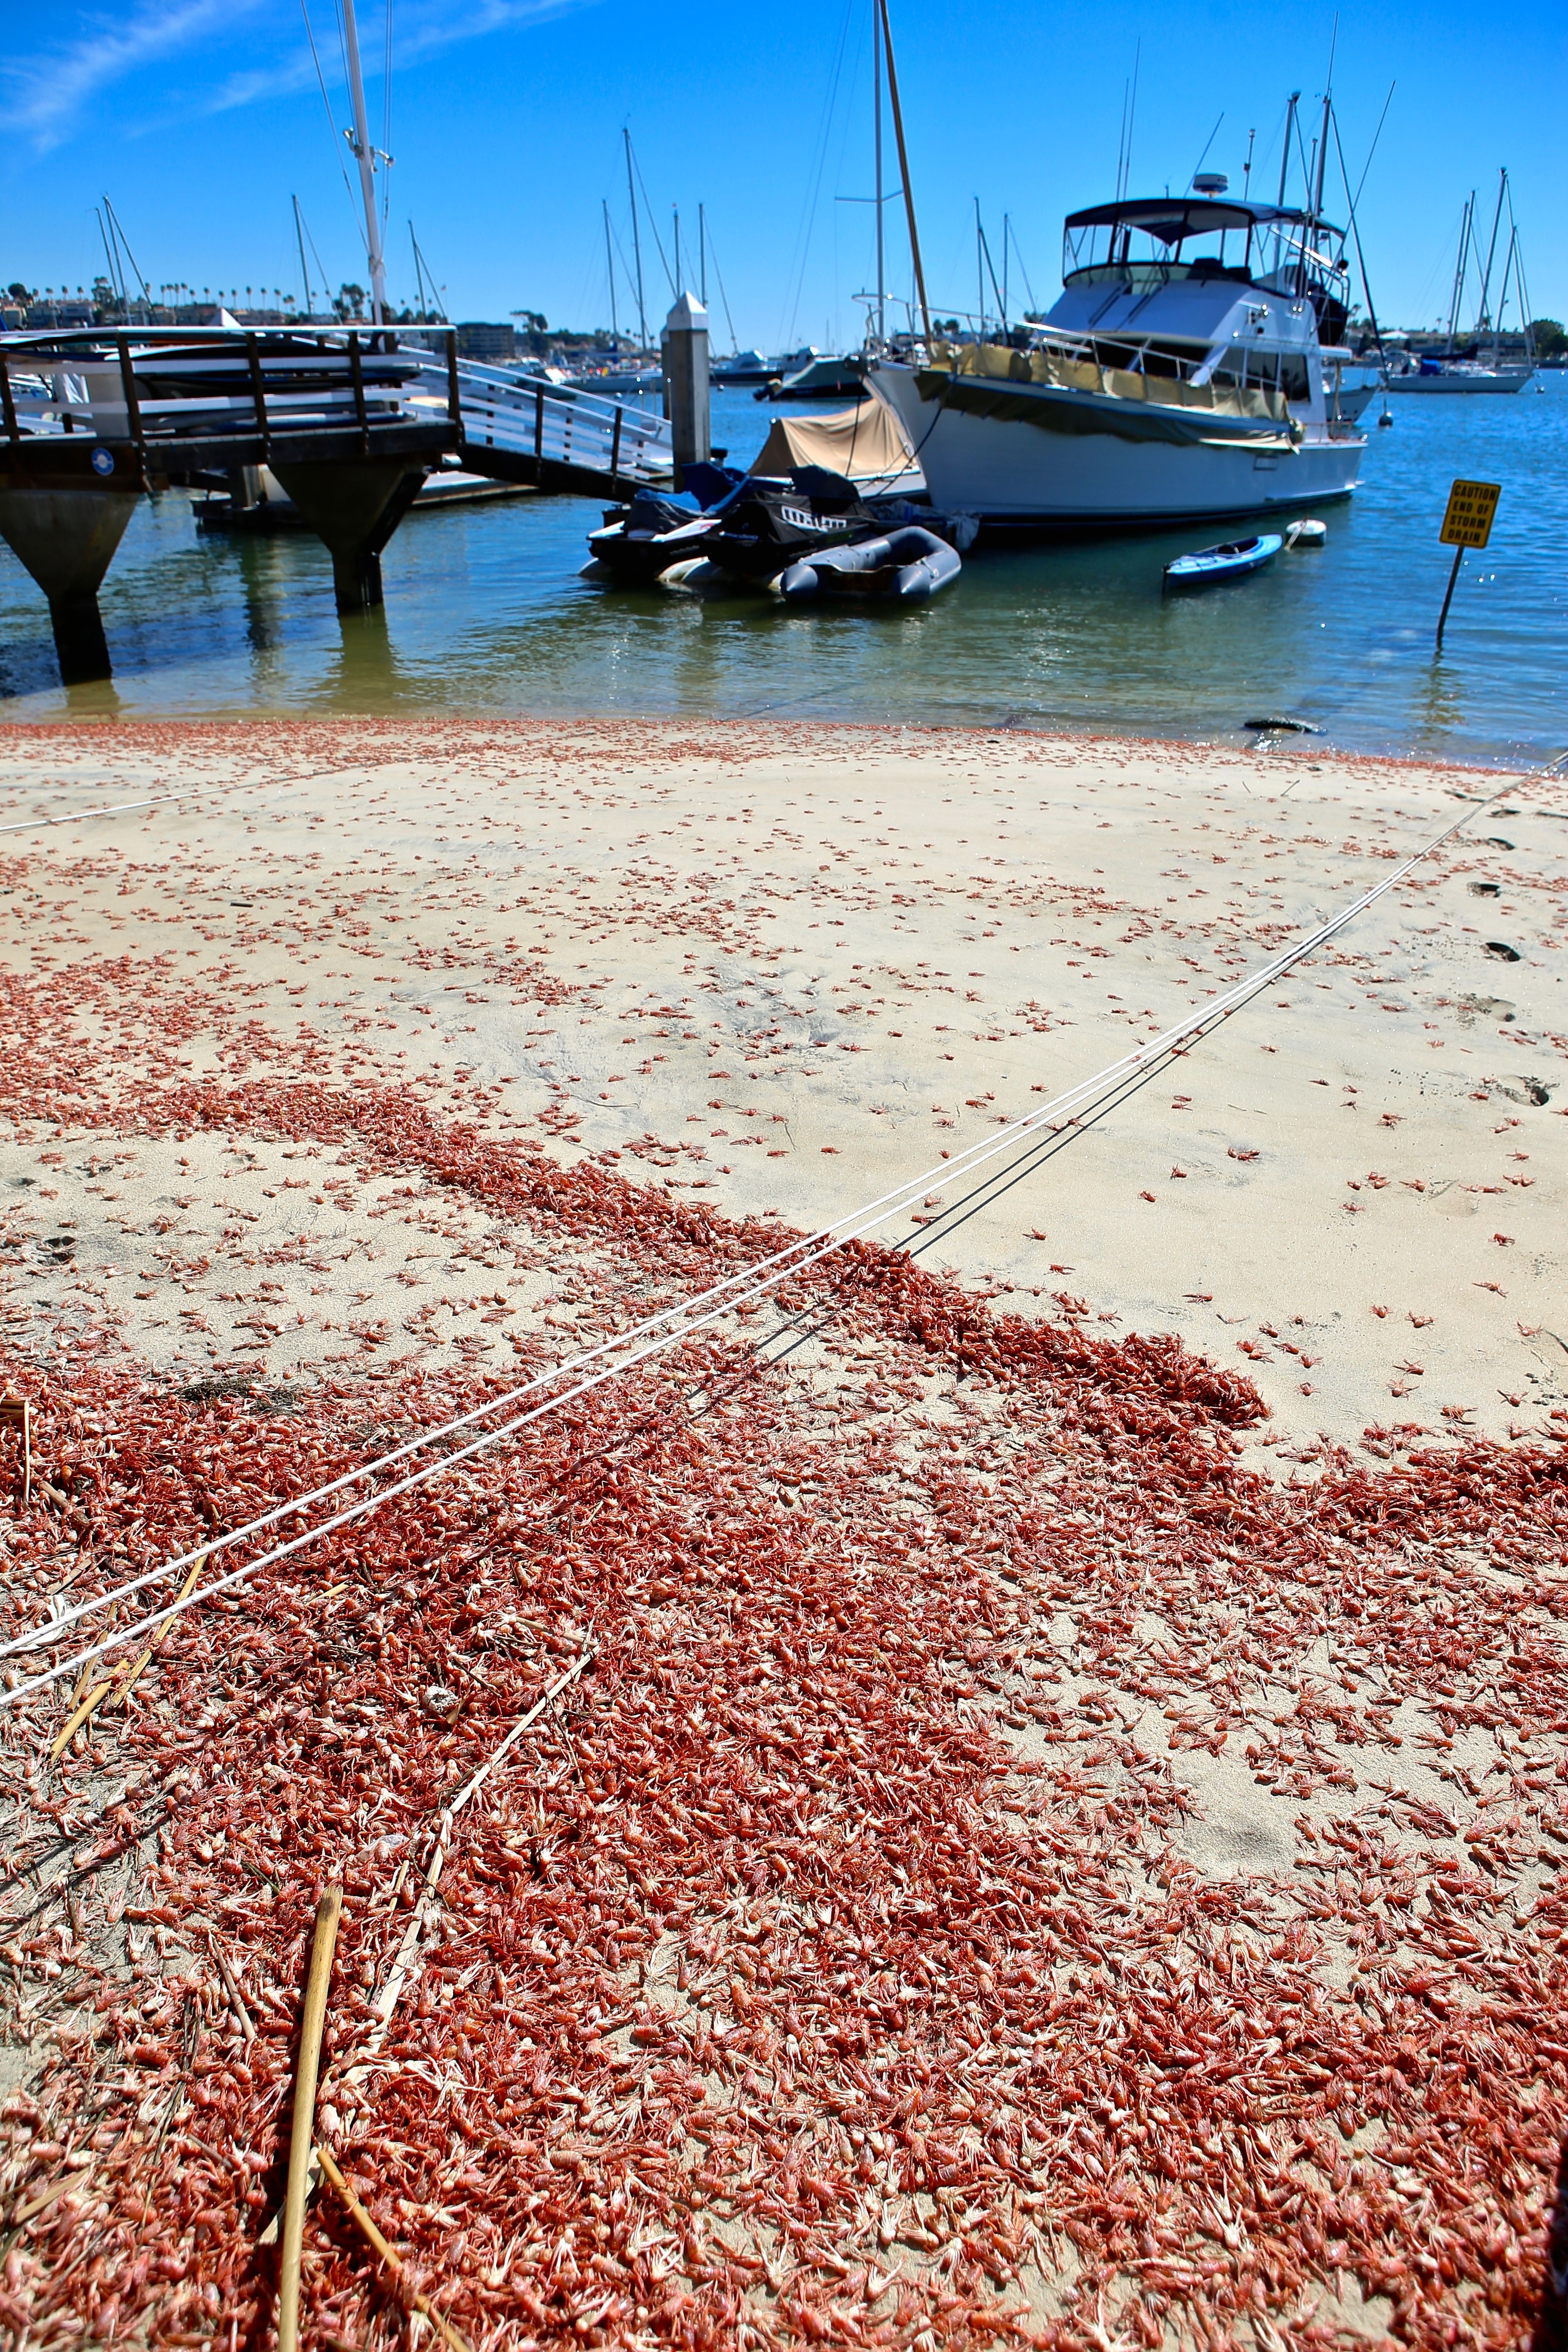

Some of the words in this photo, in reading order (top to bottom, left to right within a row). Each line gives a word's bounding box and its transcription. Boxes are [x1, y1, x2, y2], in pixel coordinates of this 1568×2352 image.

[1455, 485, 1496, 500] CAUTION
[1453, 501, 1473, 512] END
[1477, 504, 1488, 514] OF
[1450, 515, 1485, 528] STORM
[1448, 529, 1480, 542] DRAIN
